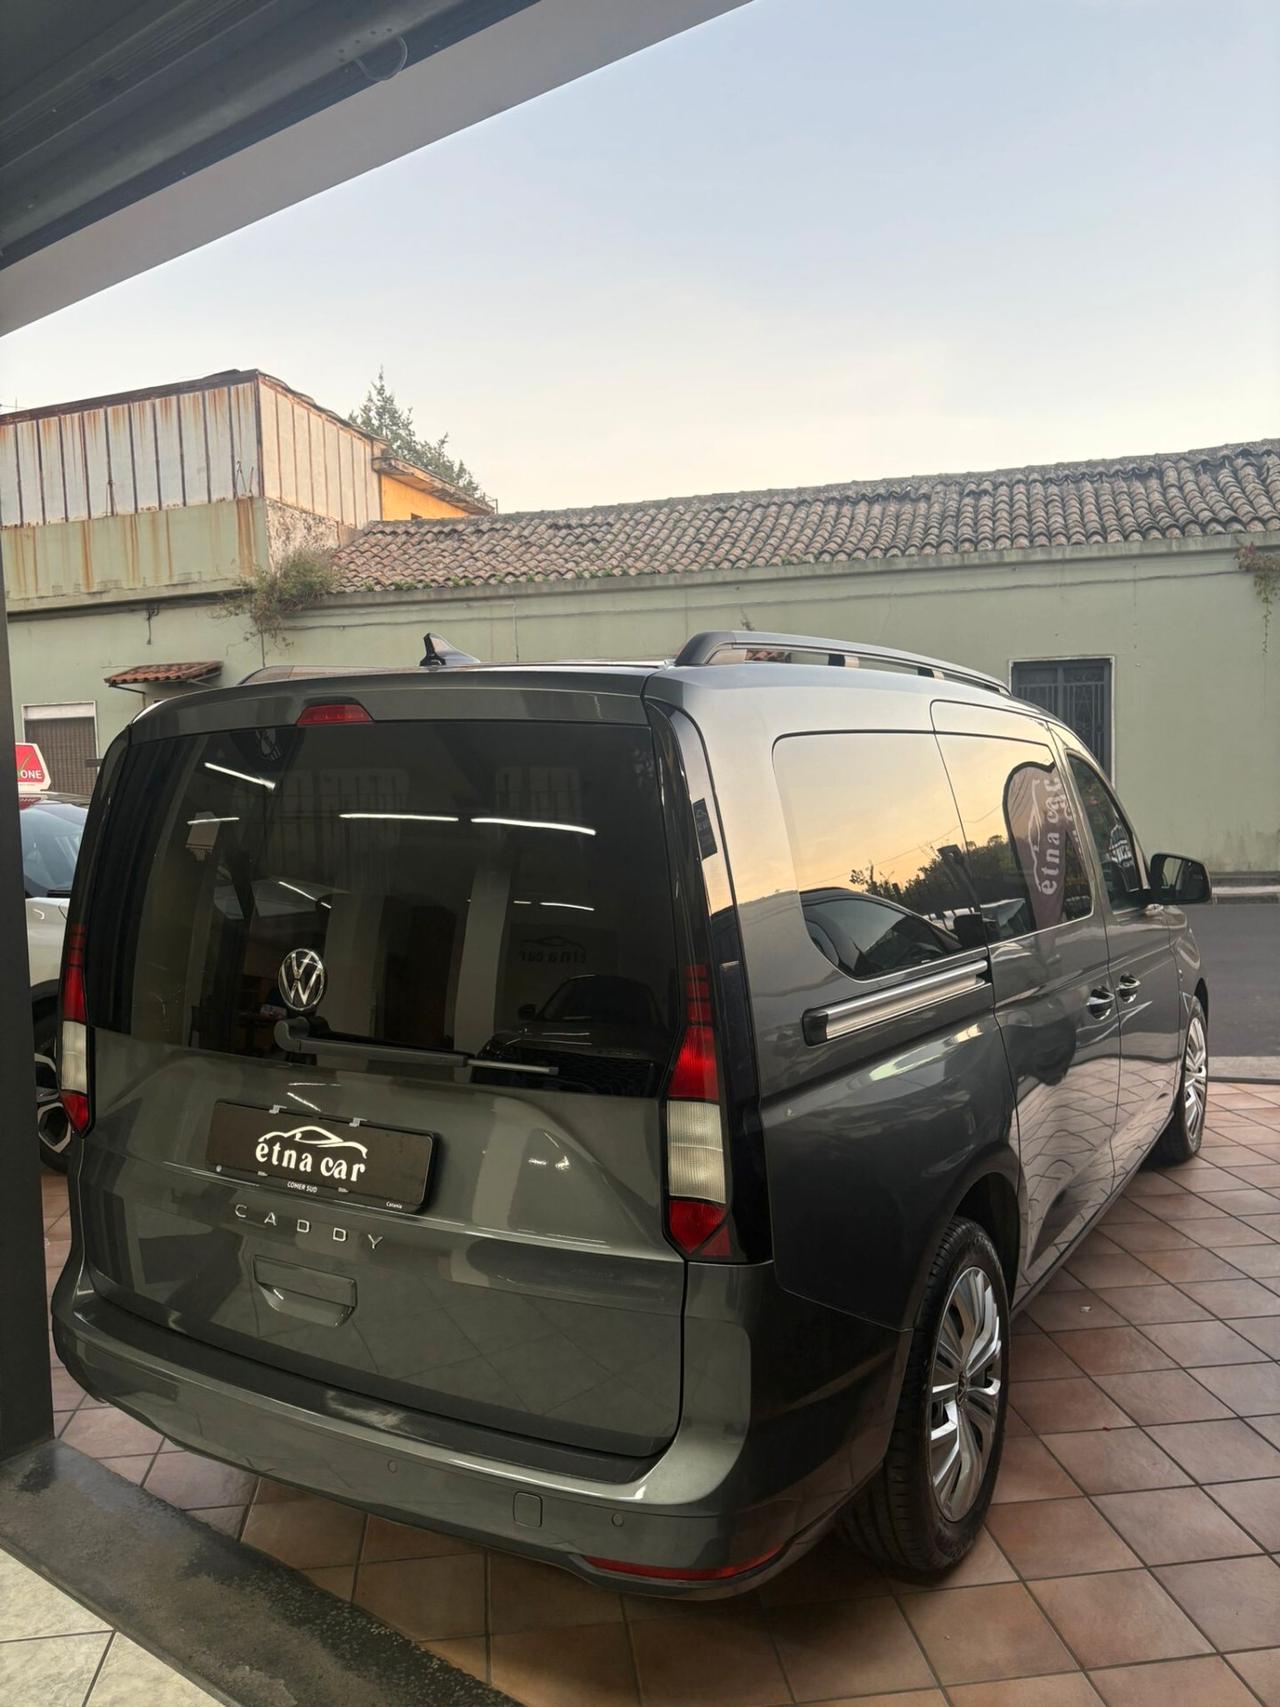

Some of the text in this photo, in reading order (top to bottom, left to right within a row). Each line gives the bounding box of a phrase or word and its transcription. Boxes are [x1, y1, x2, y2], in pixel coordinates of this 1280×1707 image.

[1041, 832, 1060, 895] etna
[255, 1142, 366, 1182] etna car
[287, 1181, 318, 1193] COMER SUD
[234, 1203, 384, 1250] CADDY
